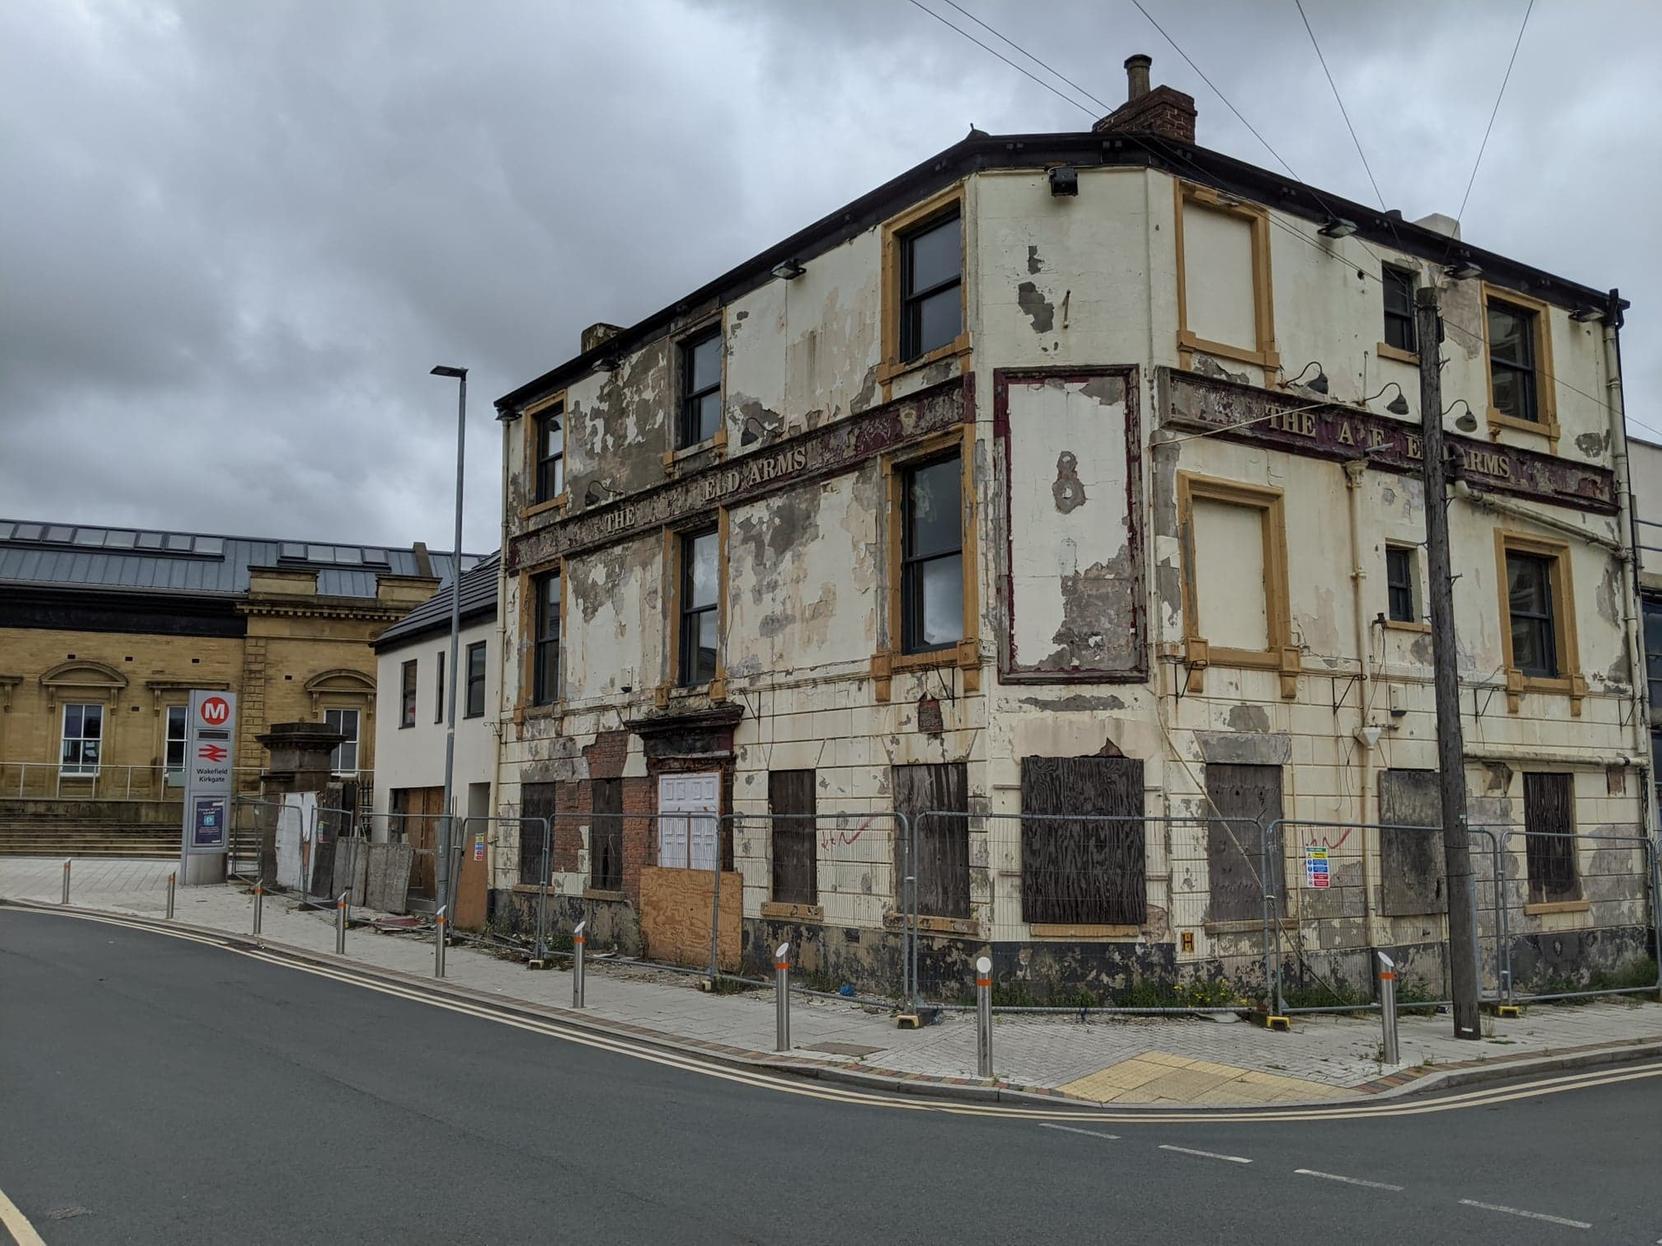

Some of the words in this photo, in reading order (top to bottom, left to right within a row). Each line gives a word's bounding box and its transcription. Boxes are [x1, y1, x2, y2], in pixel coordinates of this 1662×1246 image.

[1266, 404, 1317, 438] THE
[604, 508, 635, 534] THE
[749, 448, 806, 486] ARMS
[205, 703, 225, 719] M
[199, 776, 226, 784] Kirkgate
